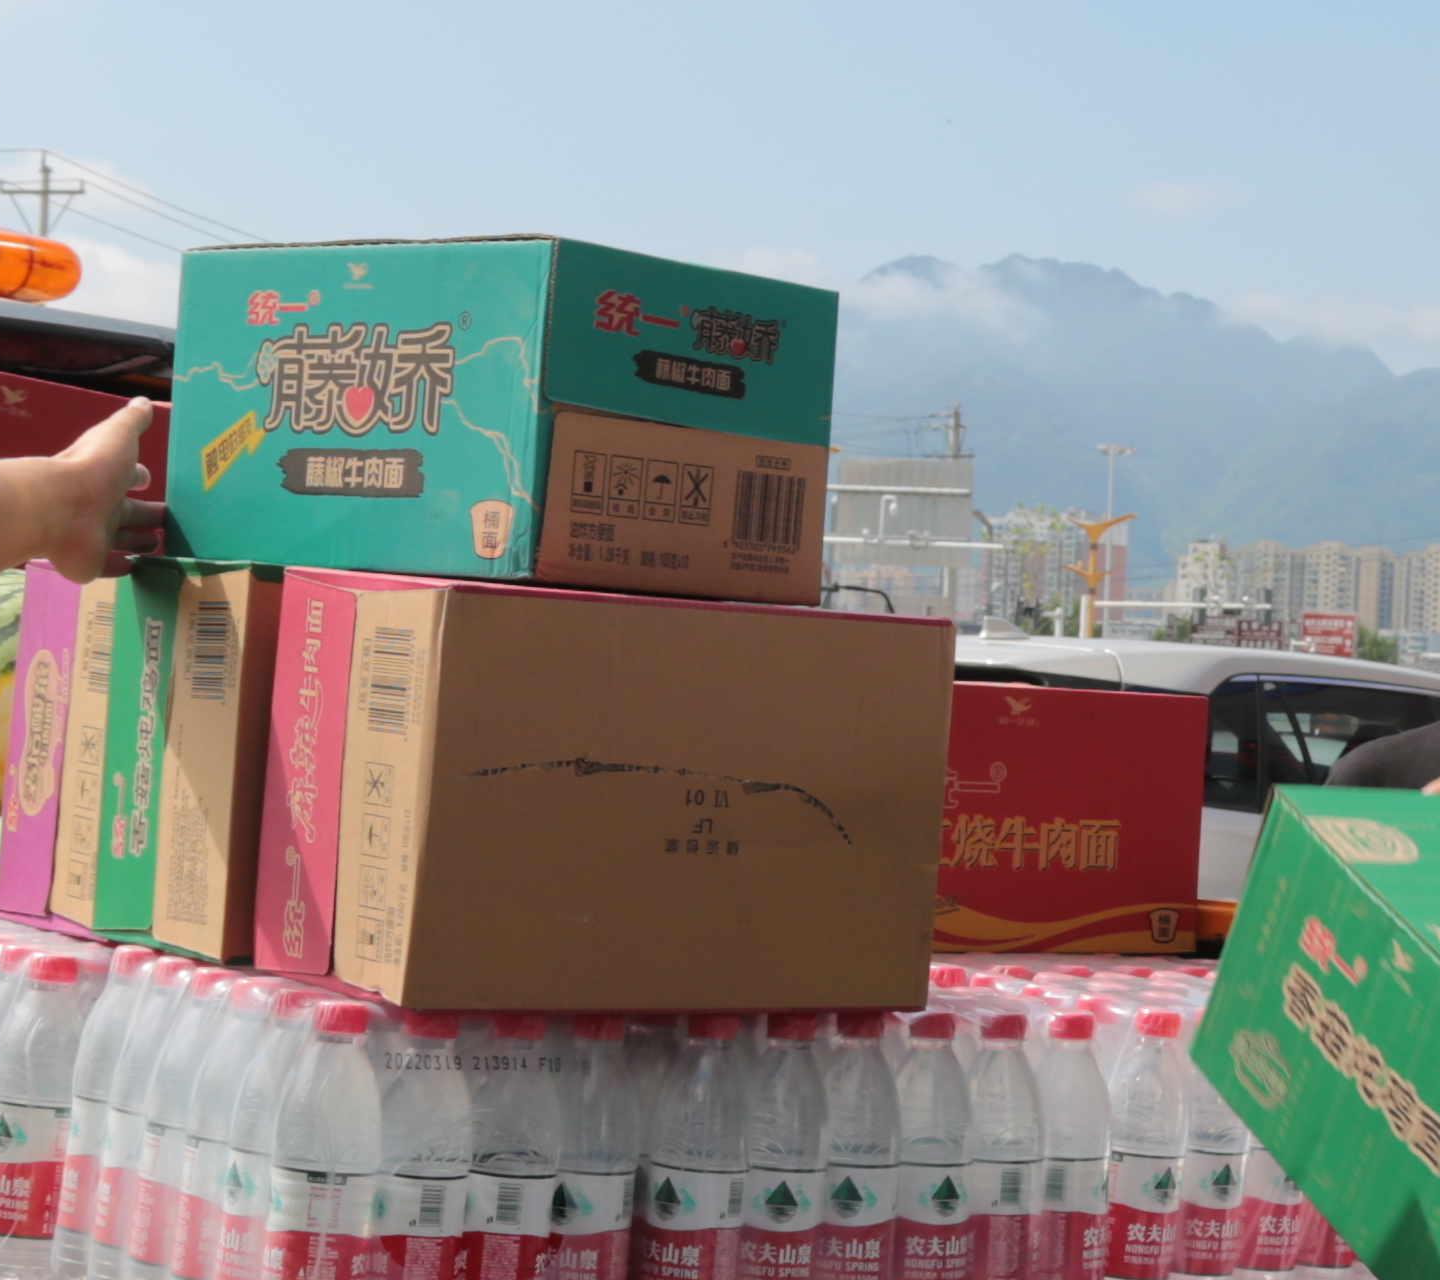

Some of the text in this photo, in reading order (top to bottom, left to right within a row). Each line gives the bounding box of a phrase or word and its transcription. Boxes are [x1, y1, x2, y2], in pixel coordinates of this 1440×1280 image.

[246, 290, 310, 326] 统一
[593, 289, 681, 337] 统一
[257, 321, 456, 437] 藤娇
[654, 357, 732, 392] 藤椒牛肉面
[304, 455, 406, 491] 藤椒牛肉面
[481, 509, 501, 551] 桶面
[130, 618, 164, 858] 香菇炖鸡面
[286, 597, 325, 845] 麻辣牛肉面
[685, 788, 706, 807] 01
[111, 777, 128, 859] 统一
[692, 817, 714, 834] LF
[283, 853, 306, 960] 统一
[384, 1051, 462, 1071] 20220319
[472, 1055, 528, 1071] 213914
[739, 1239, 814, 1266] 农夫山泉
[844, 1260, 880, 1272] SPRING
[904, 1258, 943, 1270] NONGFU
[1124, 1243, 1160, 1255] NONGFU
[661, 1266, 699, 1280] SPRING
